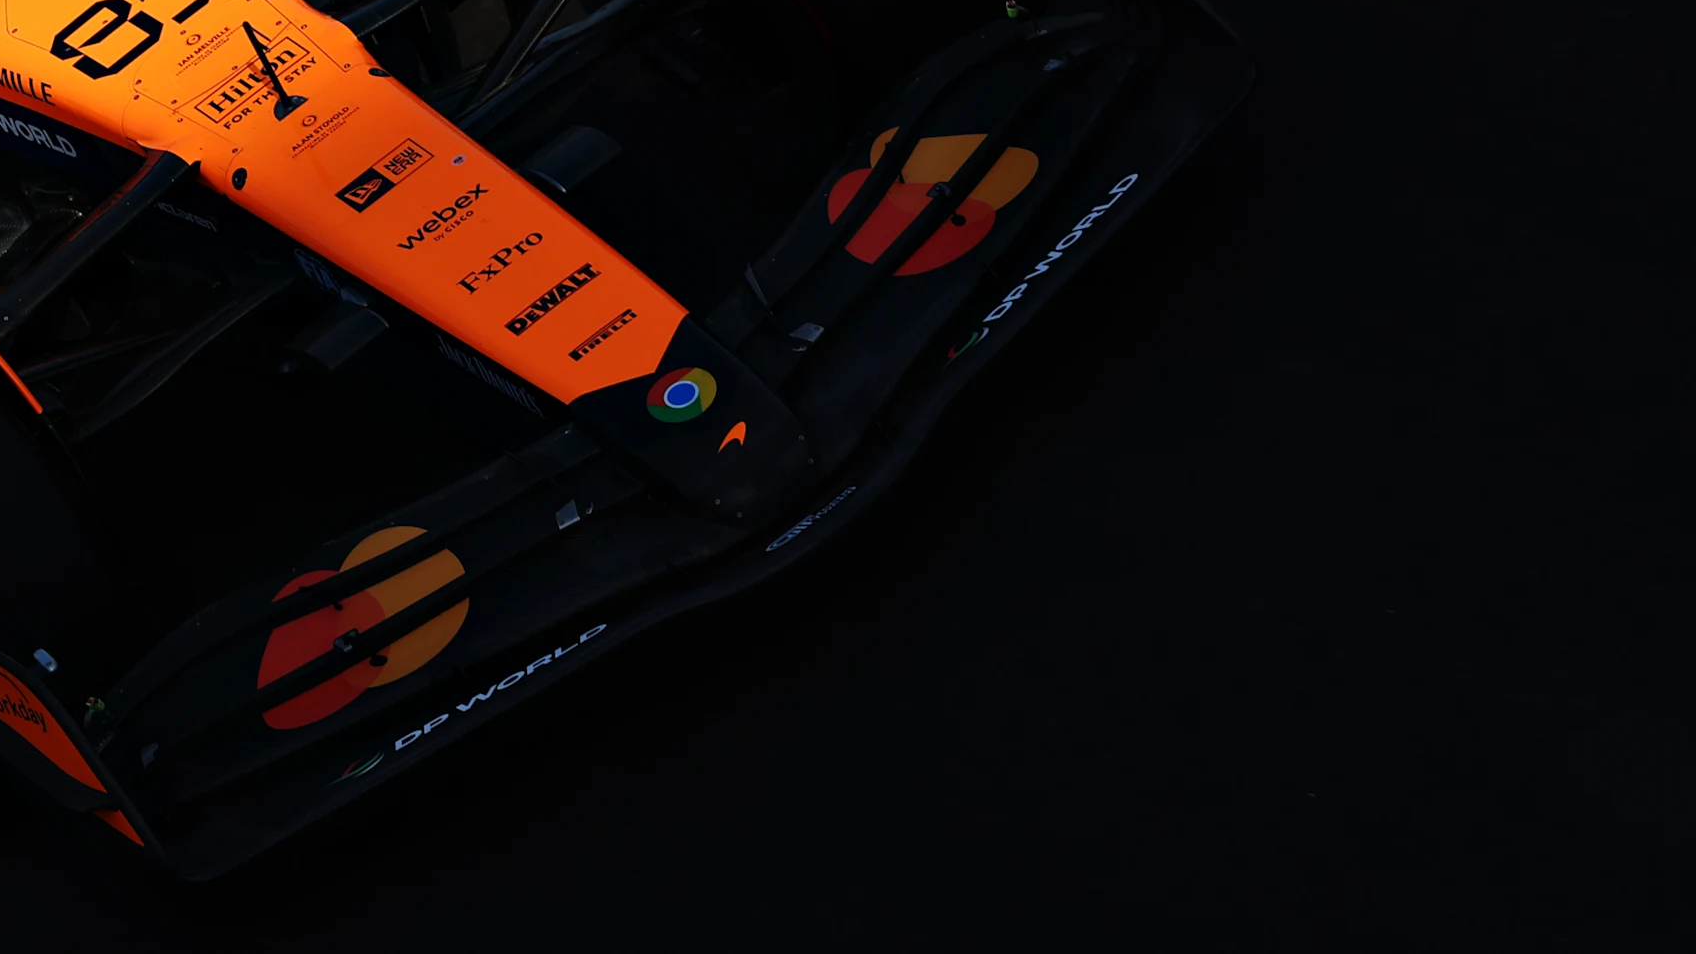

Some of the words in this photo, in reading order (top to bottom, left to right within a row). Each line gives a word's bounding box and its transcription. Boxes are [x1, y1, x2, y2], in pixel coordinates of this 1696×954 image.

[177, 54, 194, 68] IAN
[193, 26, 231, 54] MELVILLE
[208, 49, 298, 114] Hilton
[223, 107, 252, 130] FOR
[284, 56, 317, 84] STAY
[291, 133, 314, 153] ALAN
[313, 106, 350, 135] STOVOLD
[384, 146, 415, 171] NEW
[391, 152, 423, 176] ERA
[397, 183, 489, 250] webex
[433, 233, 445, 242] by
[444, 210, 474, 233] CISCO
[982, 282, 1029, 322] DP
[1023, 172, 1140, 281] WORLD
[456, 232, 543, 295] FxPro
[506, 262, 600, 336] DEWALT
[568, 308, 638, 362] PIRELLI
[394, 713, 450, 752] DP
[456, 623, 608, 713] WORLD
